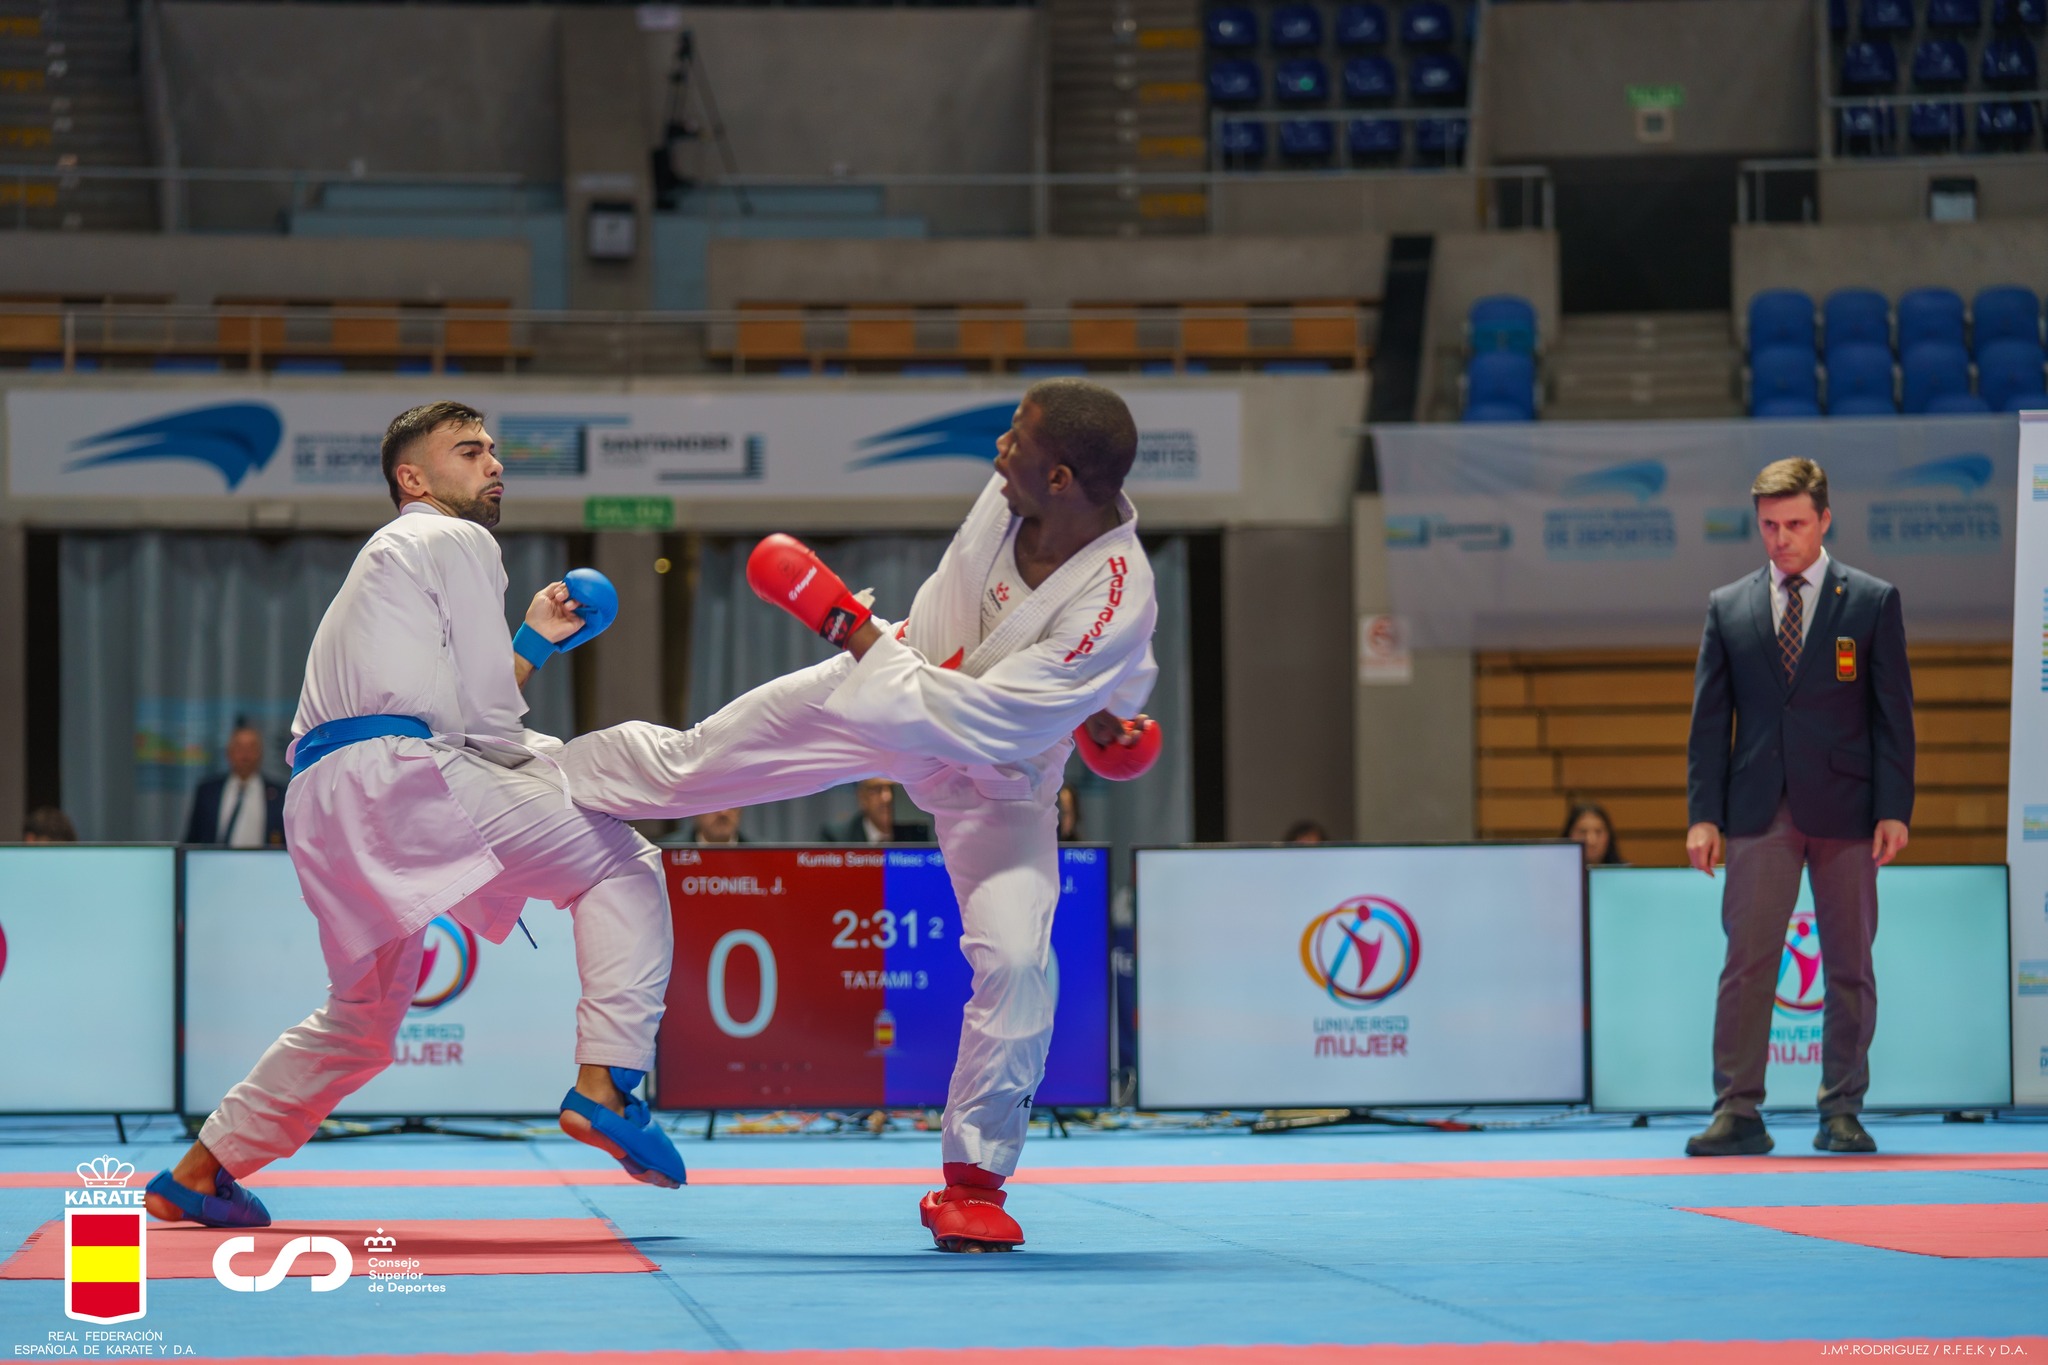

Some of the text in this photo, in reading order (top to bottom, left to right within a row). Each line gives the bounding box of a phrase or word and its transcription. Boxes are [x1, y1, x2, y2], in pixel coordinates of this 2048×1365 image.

[671, 851, 701, 865] LEA
[797, 852, 842, 867] Kumite
[845, 852, 885, 867] Senior
[1064, 849, 1097, 864] FNG
[682, 876, 787, 896] OTONIEL, J.
[832, 909, 944, 949] 2:31 2
[707, 929, 778, 1038] 0
[841, 970, 929, 990] TATAMI 3
[1313, 1016, 1409, 1033] UNIVERSO
[394, 1042, 463, 1067] UJER
[1314, 1034, 1408, 1057] MUJER
